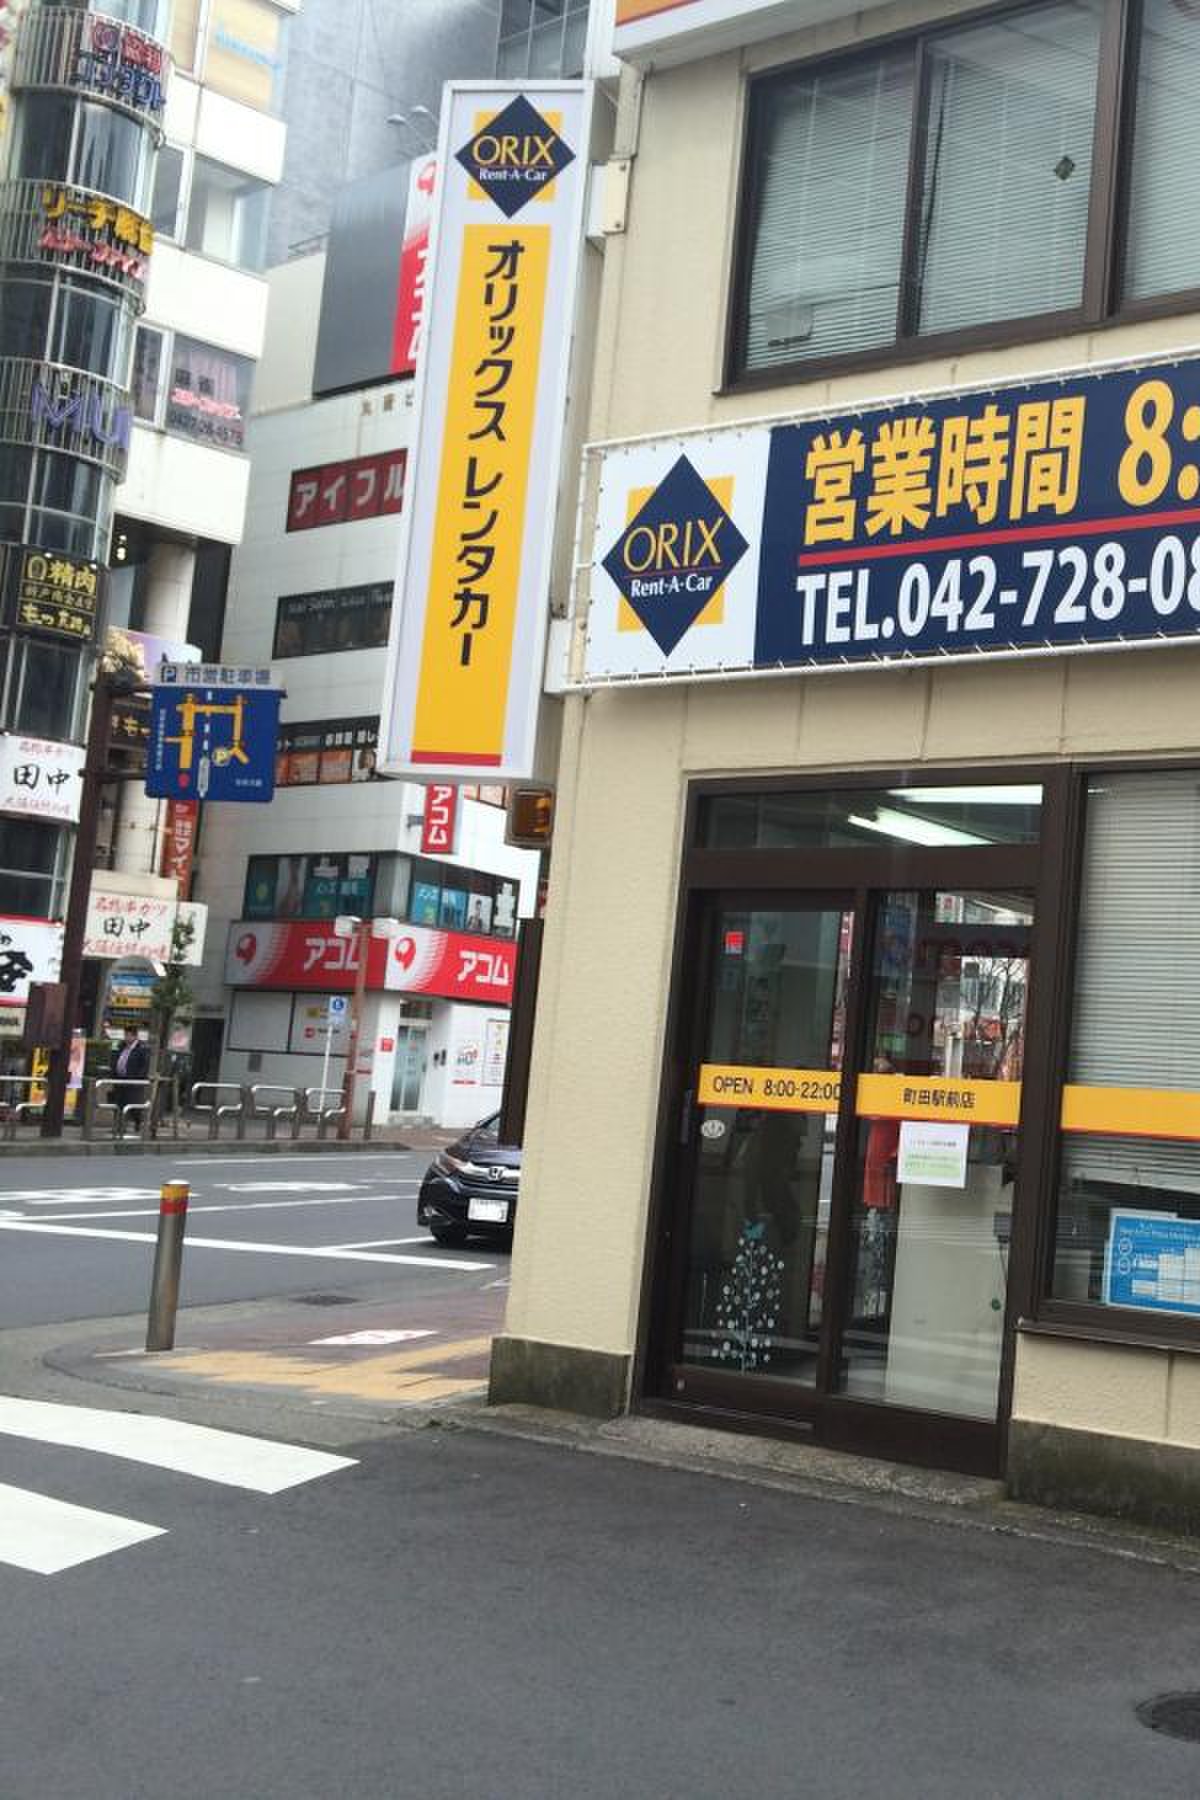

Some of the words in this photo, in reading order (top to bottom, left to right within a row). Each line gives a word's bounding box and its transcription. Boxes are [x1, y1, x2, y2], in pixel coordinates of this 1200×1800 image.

[472, 135, 555, 166] ORIX
[479, 167, 548, 182] Rent-A-Car
[468, 240, 525, 441] オリックス
[803, 395, 1087, 545] 営業時間
[295, 463, 402, 517] アイフル
[450, 457, 503, 666] レンタカー
[622, 516, 725, 573] ORIX
[630, 573, 714, 599] Rent-A-Car
[13, 763, 71, 797] 田中
[428, 785, 454, 846] アコム
[103, 917, 151, 941] 田中
[457, 950, 510, 986] アコム
[712, 1076, 754, 1094] OPEN
[763, 1079, 842, 1100] 8:00-22:00
[903, 1088, 975, 1109] 町田駅前店
